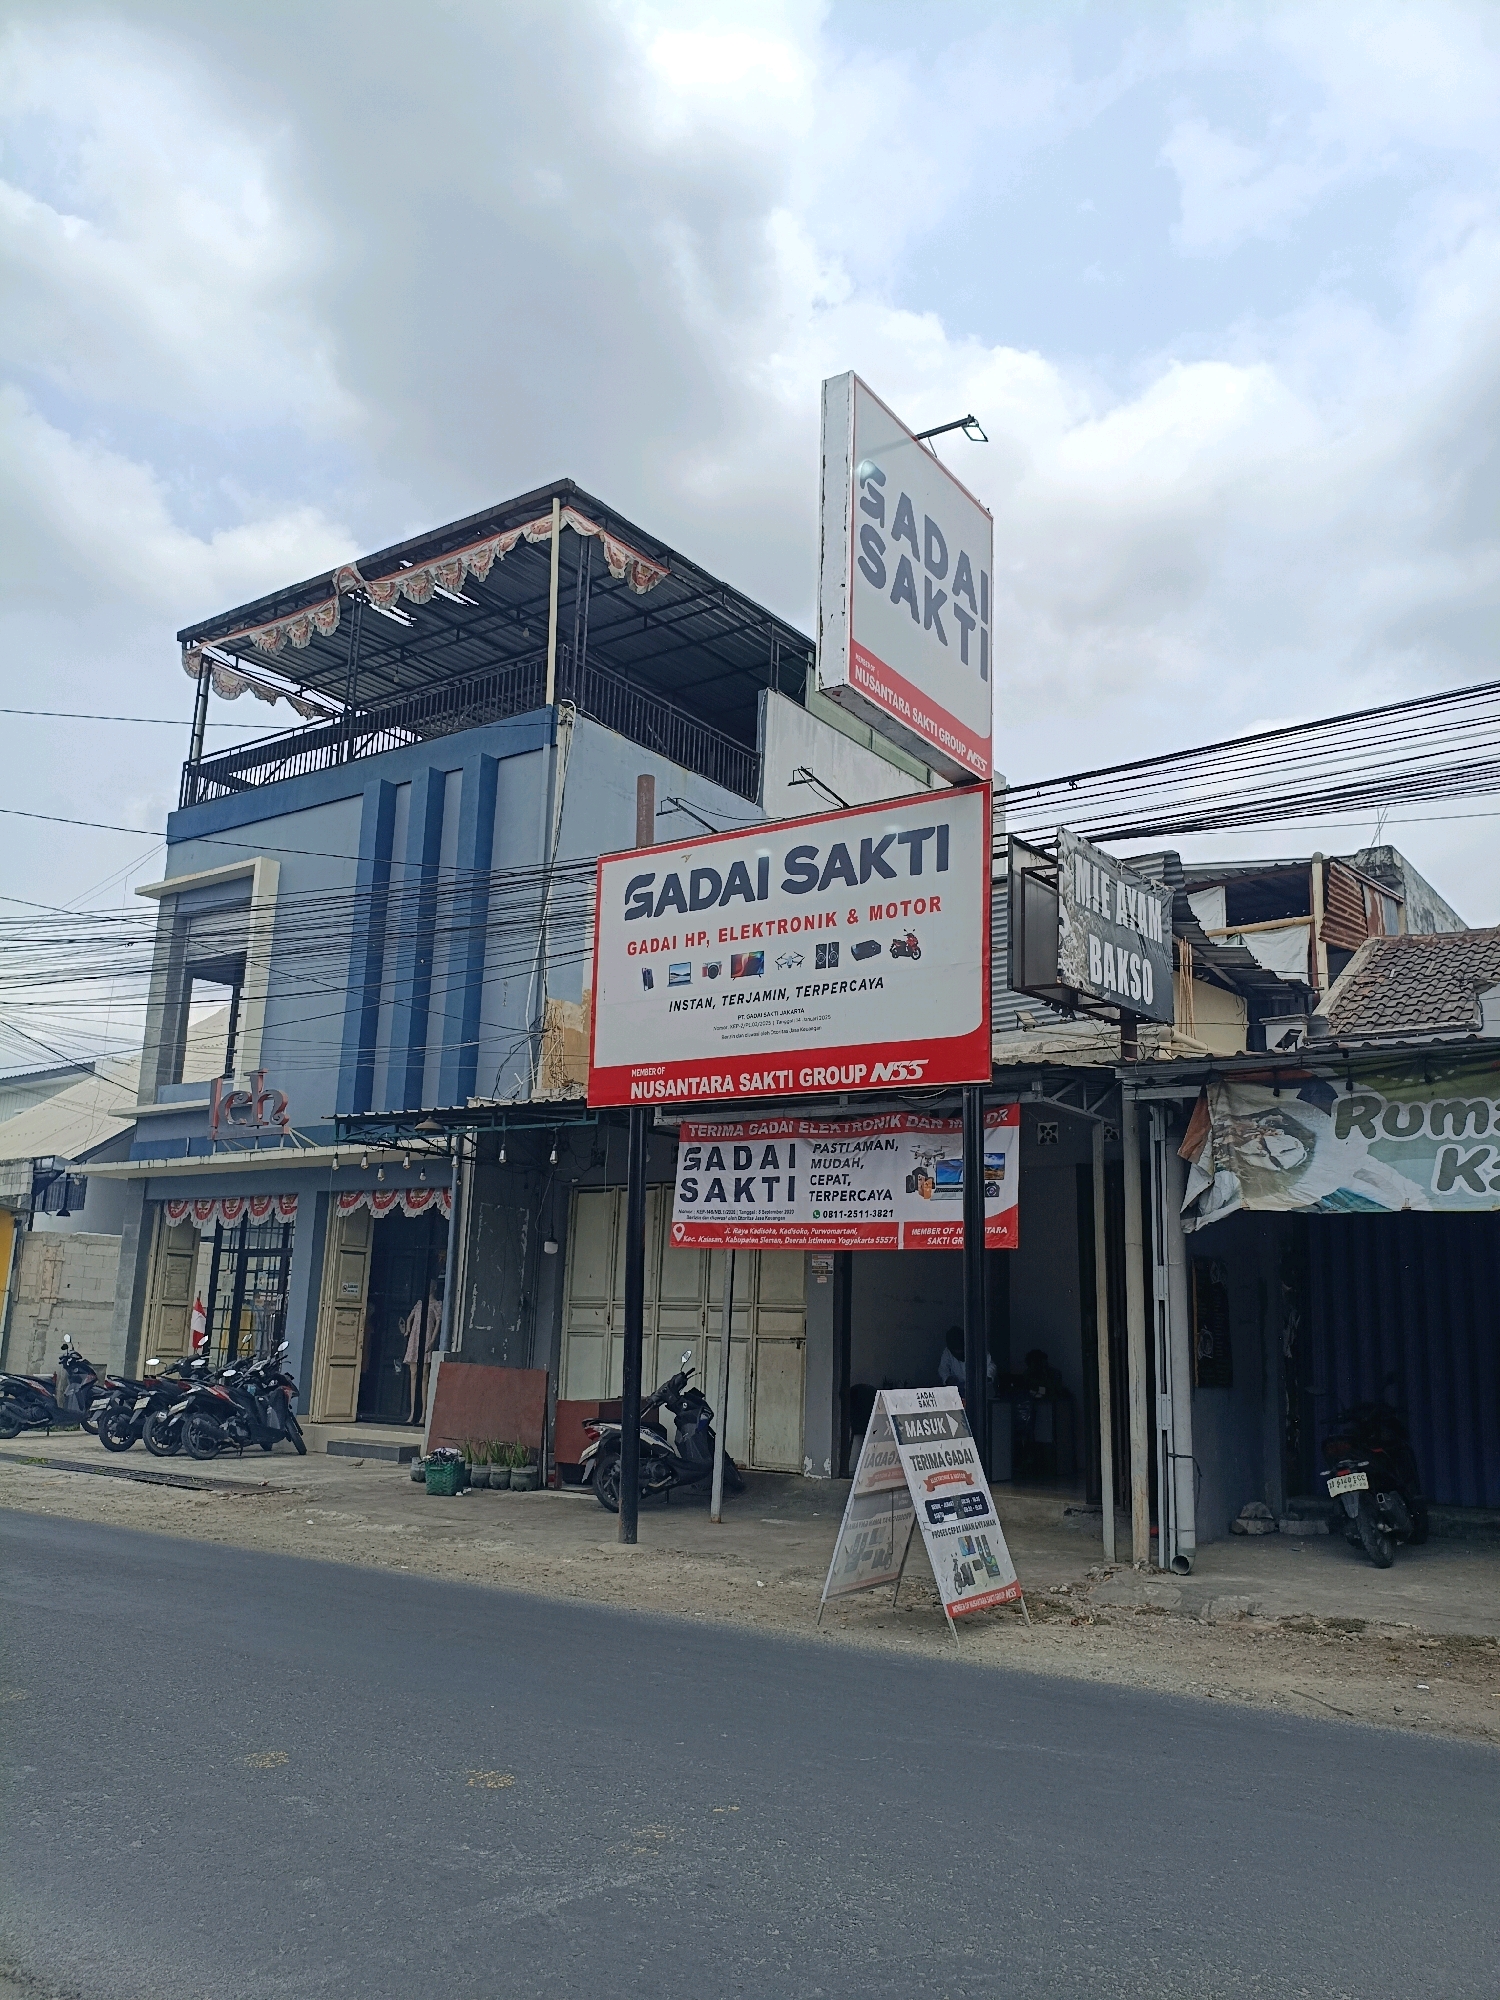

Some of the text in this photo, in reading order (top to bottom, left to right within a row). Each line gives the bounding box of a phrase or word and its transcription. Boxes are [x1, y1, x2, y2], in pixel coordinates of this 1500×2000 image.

[860, 459, 988, 626] GADAI
[858, 523, 988, 683] SAKTI
[855, 652, 871, 670] MEMBER
[854, 665, 911, 718] NUSANTARA
[912, 707, 938, 737] SAKTI
[938, 727, 967, 757] GROUP
[624, 823, 950, 921] GADAI SAKTI
[1074, 853, 1163, 944] MIE AYAM
[627, 895, 942, 956] GADAI HP, ELEKTRONIK & MOTOR
[1088, 933, 1154, 1006] BAKSO
[668, 976, 884, 1013] INSTAN, TERJAMIN, TERPERCAYA
[746, 1012, 763, 1020] GADAI
[763, 1010, 779, 1018] SAKTI
[780, 1007, 805, 1016] JAKARTA
[630, 1075, 734, 1100] NUSANTARA
[739, 1069, 794, 1091] SAKTI
[799, 1063, 867, 1087] GROUP
[631, 1066, 666, 1077] MEMBER OF
[688, 1124, 744, 1137] TERIMA
[748, 1120, 794, 1134] GADAI
[798, 1114, 902, 1134] ELEKTRONIK
[906, 1115, 943, 1128] DAN
[1335, 1095, 1500, 1140] Rum
[683, 1143, 796, 1172] GADAI
[812, 1138, 899, 1154] PASTI AMAN,
[810, 1157, 864, 1170] MUDAH,
[1436, 1147, 1500, 1193] K
[679, 1175, 796, 1203] SAKTI
[810, 1173, 852, 1187] CEPAT,
[808, 1188, 893, 1202] TERPERCAYA
[822, 1209, 894, 1219] 0811-2511-3821
[733, 1227, 749, 1236] Raya
[784, 1236, 806, 1244] Daerah
[807, 1236, 836, 1244] Istimewa
[838, 1236, 875, 1246] Yogyakarta
[875, 1236, 898, 1244] 55571
[911, 1227, 941, 1235] MEMBER
[942, 1226, 954, 1235] OF
[927, 1236, 950, 1245] SAKTI
[918, 1399, 938, 1408] SAKTI
[904, 1416, 947, 1438] MASUK
[909, 1451, 947, 1472] TERIMA
[944, 1447, 975, 1468] GADAI
